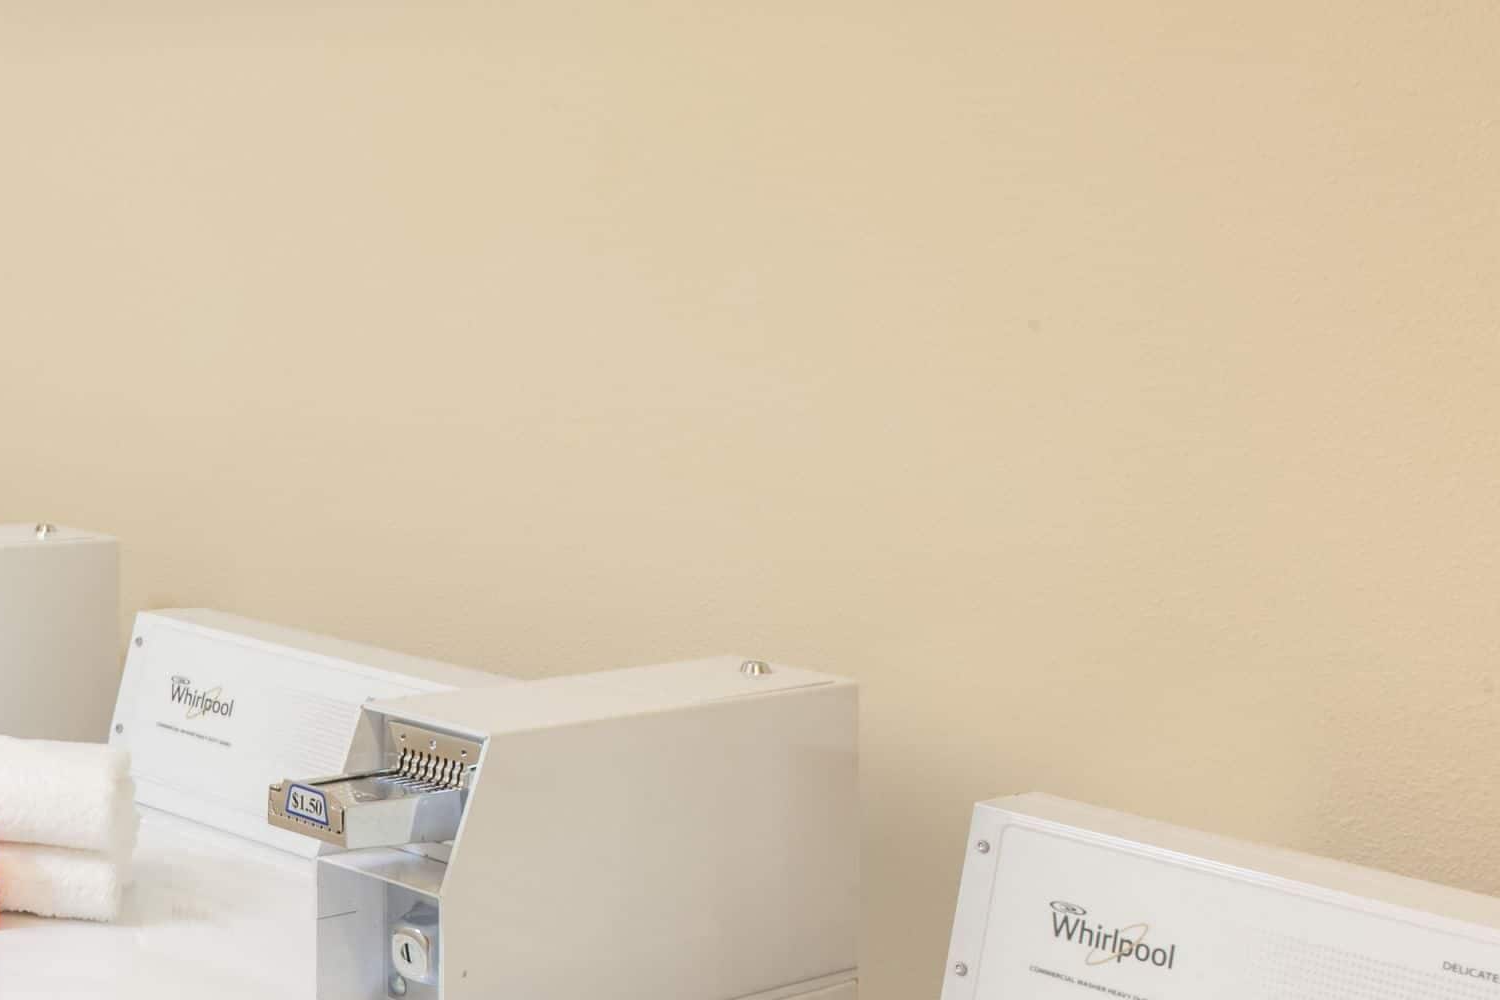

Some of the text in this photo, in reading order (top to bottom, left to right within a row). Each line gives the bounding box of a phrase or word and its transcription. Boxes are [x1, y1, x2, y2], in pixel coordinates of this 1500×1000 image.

[170, 682, 235, 717] Whirlpool
[291, 790, 323, 817] $1.50
[1051, 911, 1176, 970] Whirlpool
[1029, 964, 1075, 984] COMMERCIAL
[1077, 979, 1106, 993] WASHER
[1108, 988, 1132, 1000] HEAVY
[1442, 960, 1500, 984] DELICATE
